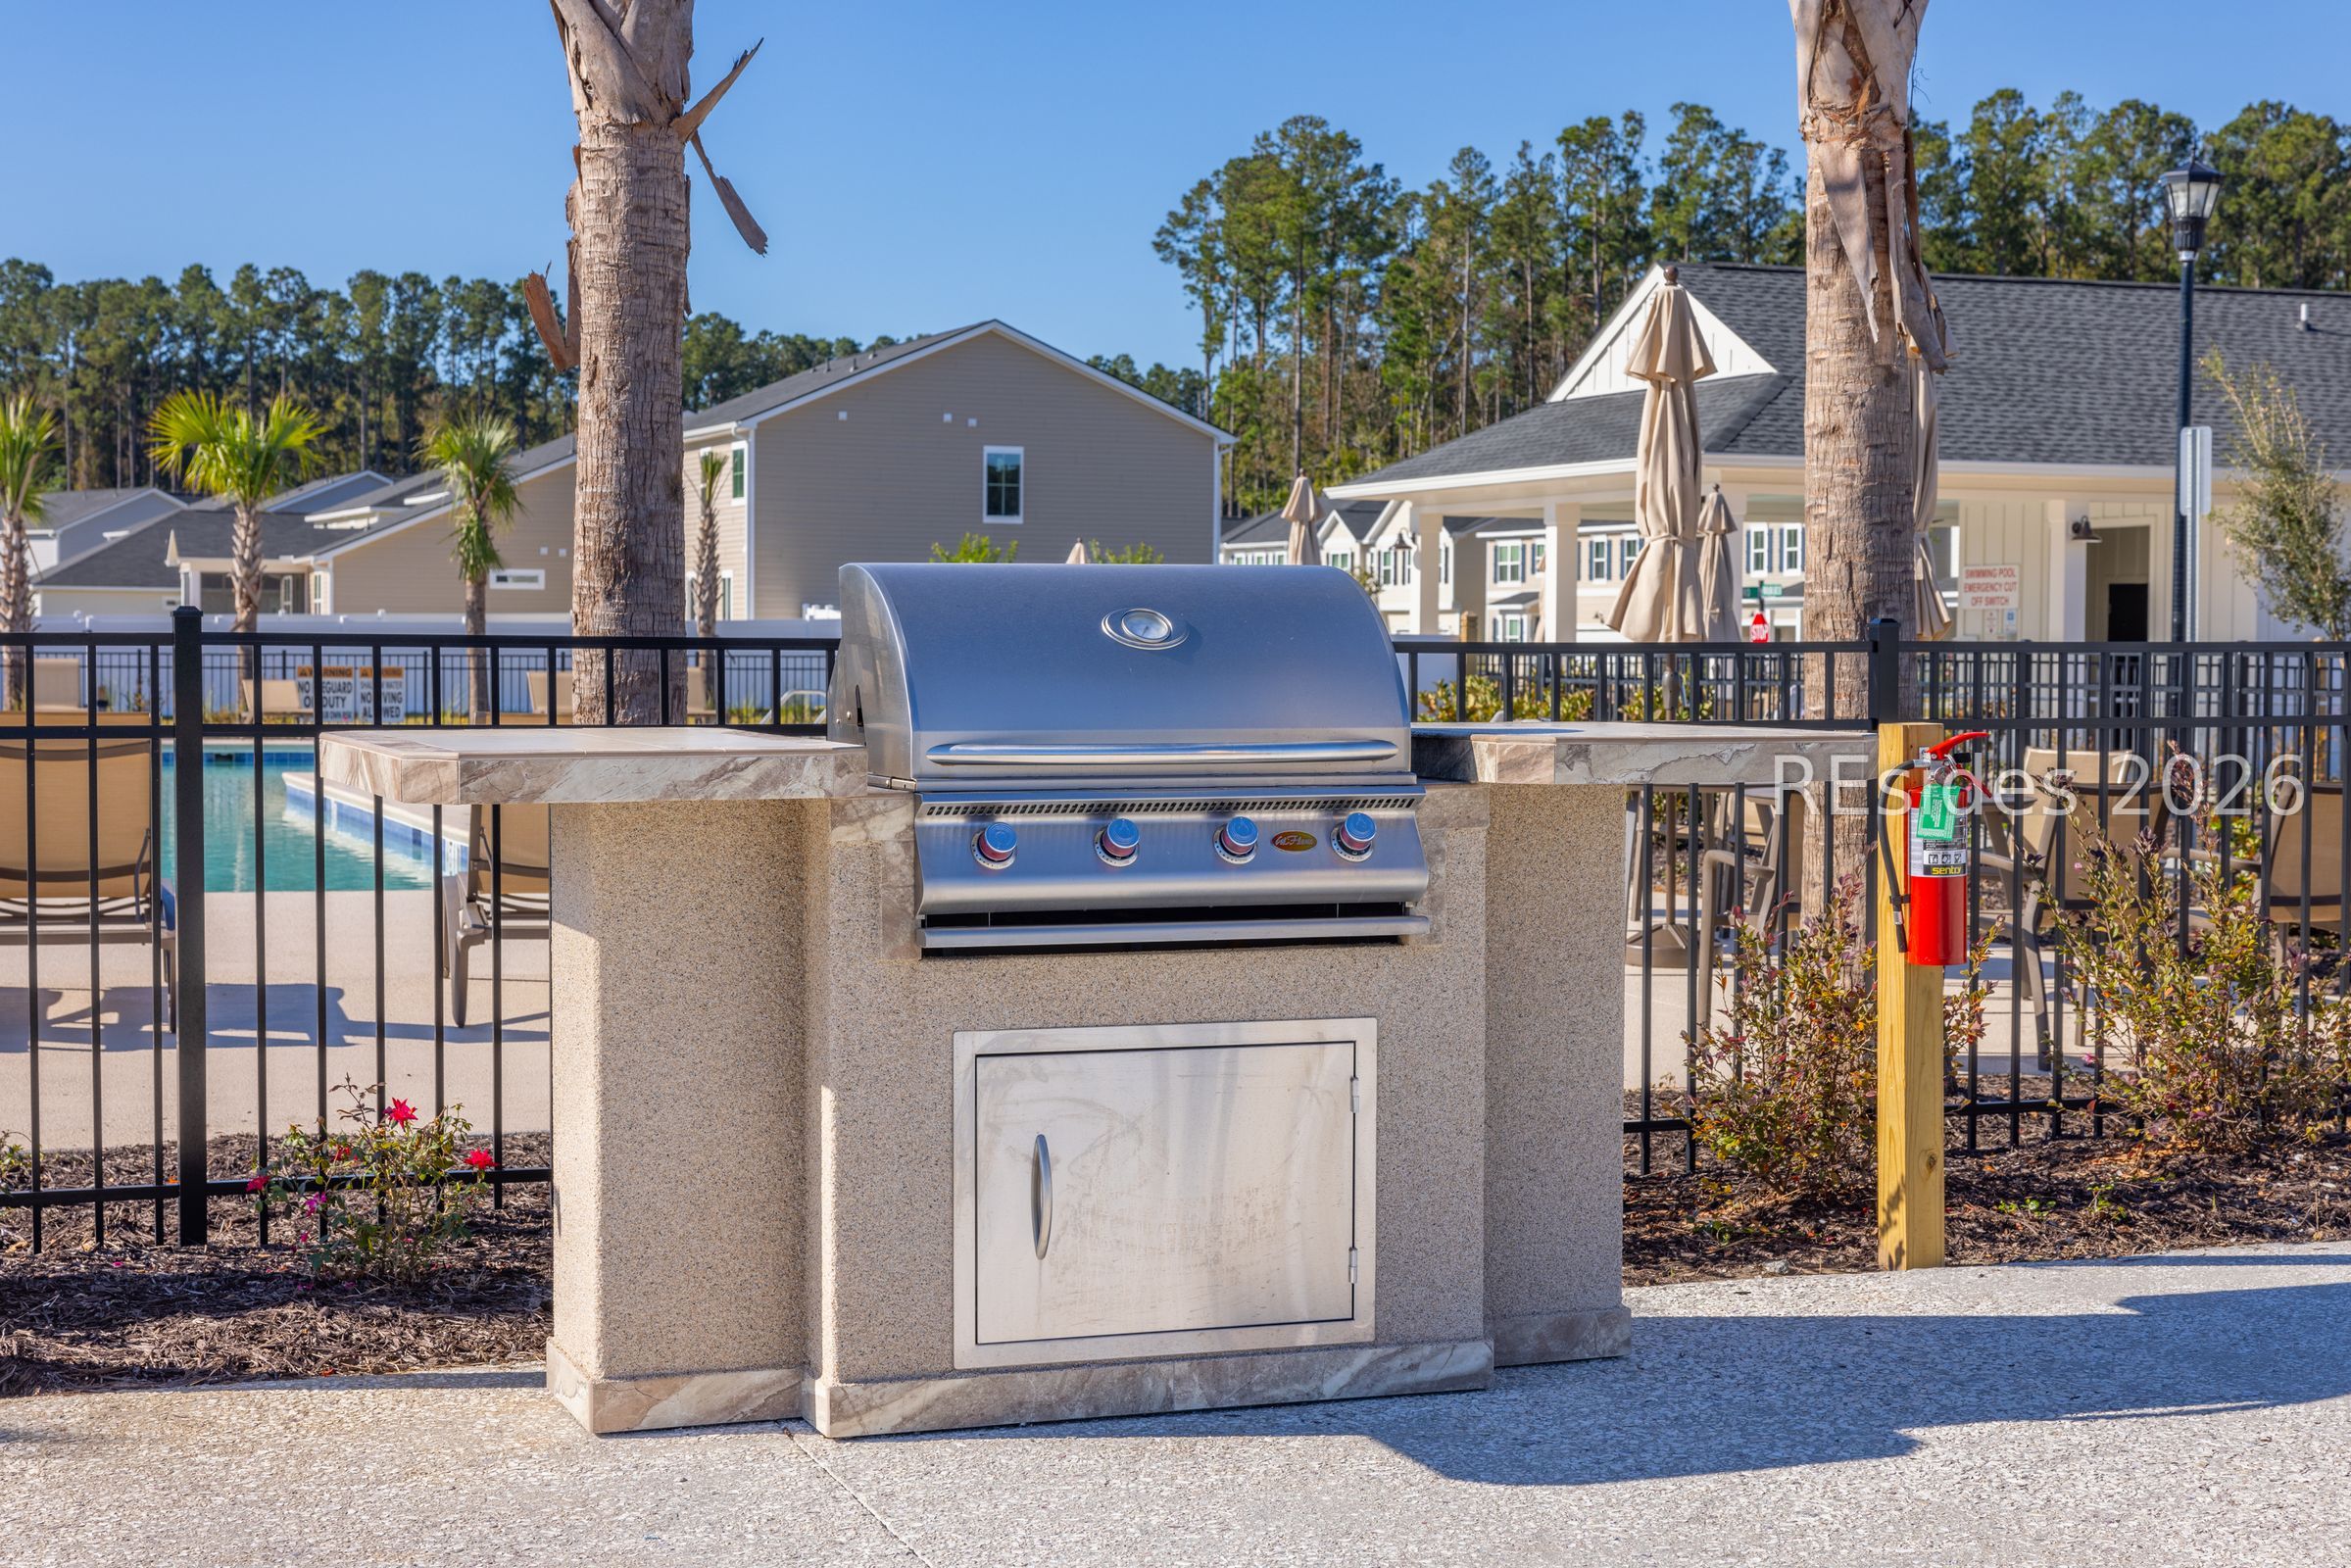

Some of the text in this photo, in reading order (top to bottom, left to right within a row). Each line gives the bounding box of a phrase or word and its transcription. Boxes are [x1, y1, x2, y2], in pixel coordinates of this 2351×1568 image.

[1965, 567, 2016, 579] SWIMMING POOL
[1964, 582, 2002, 593] EMERGENCY
[1971, 595, 2009, 607] OFF SWITCH
[1750, 624, 1769, 640] STOP
[298, 680, 310, 693] NO
[322, 696, 346, 709] DUTY
[361, 691, 372, 704] NO
[363, 706, 401, 718] ALWED
